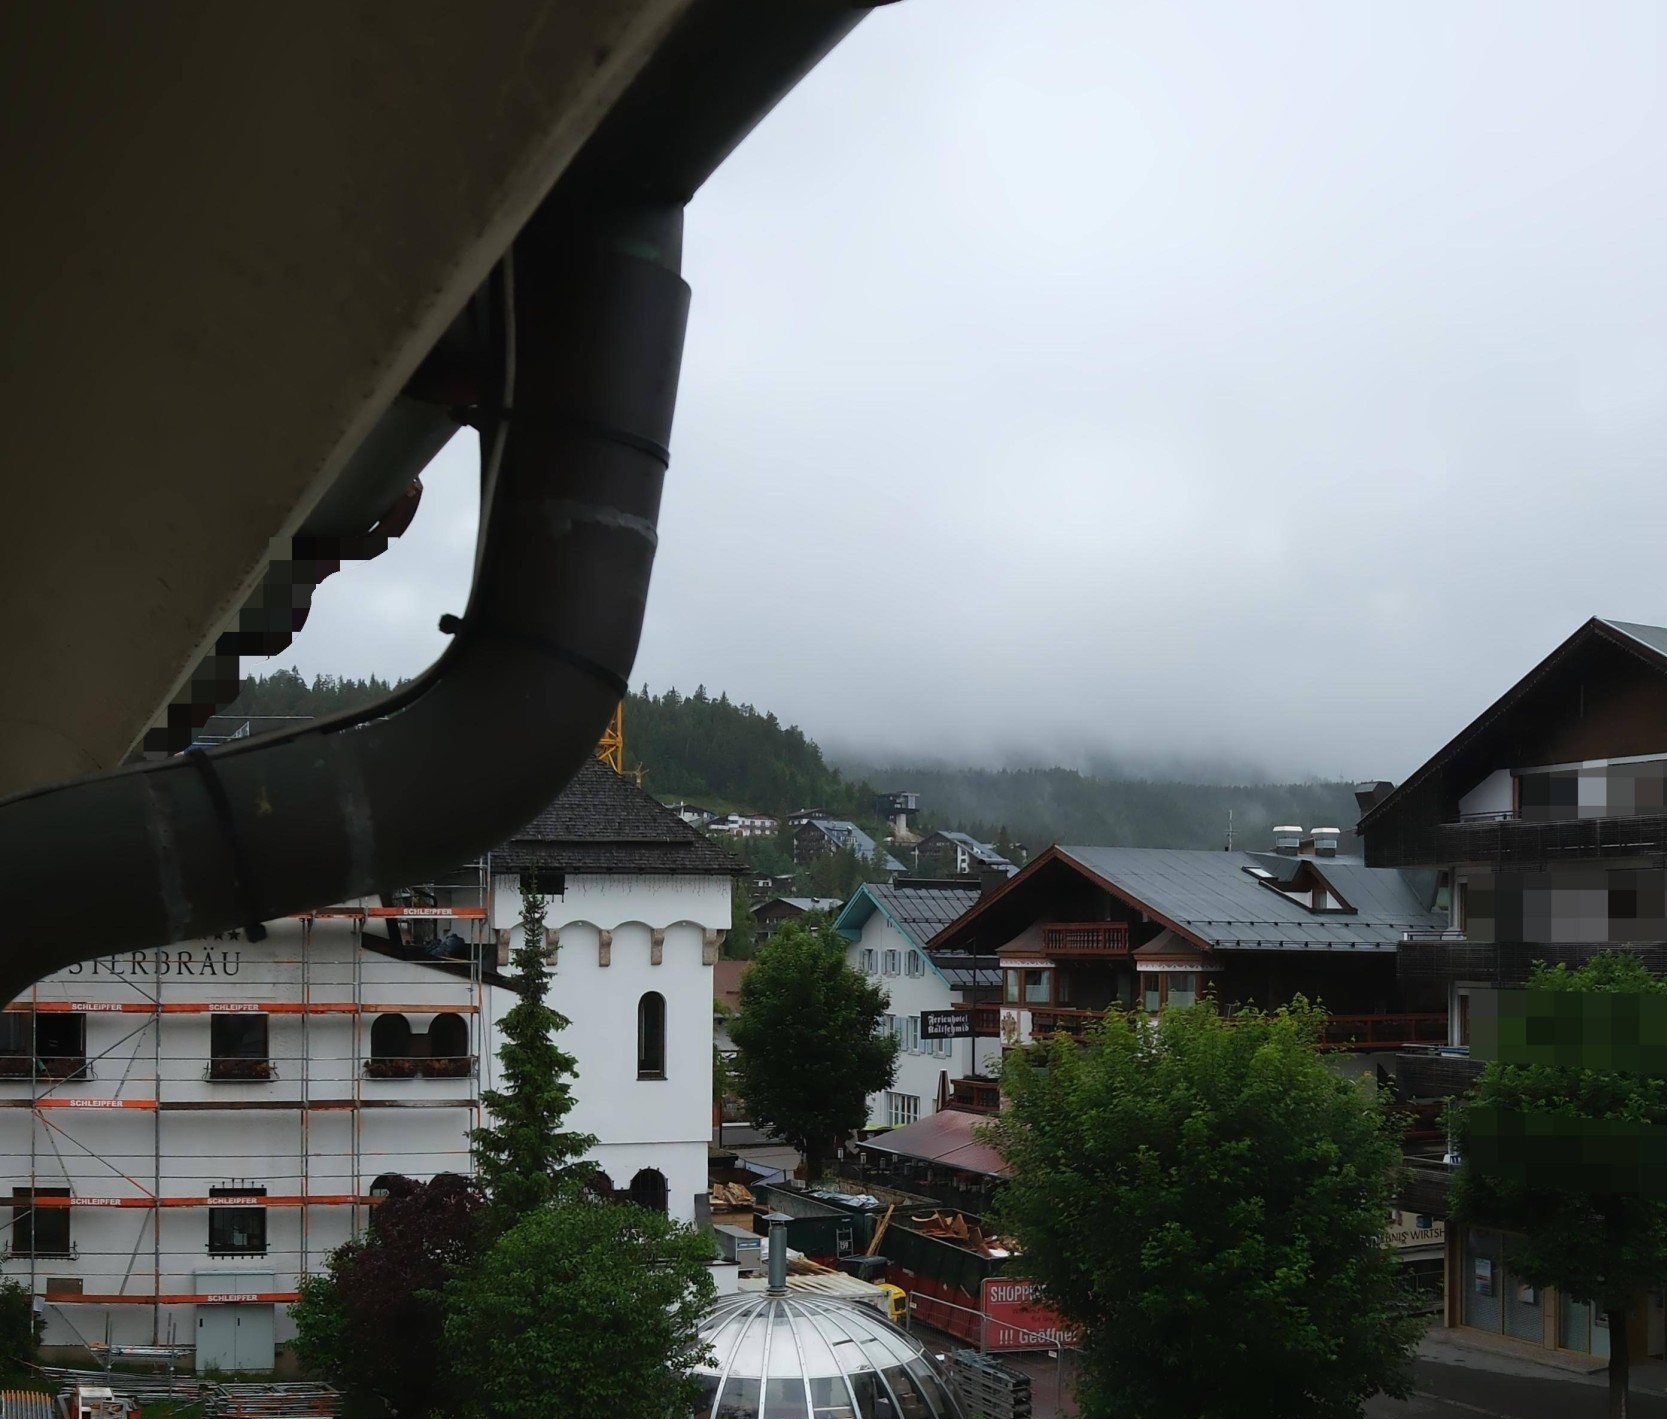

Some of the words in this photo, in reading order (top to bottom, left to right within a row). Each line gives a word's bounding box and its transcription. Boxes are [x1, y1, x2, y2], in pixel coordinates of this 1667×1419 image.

[403, 908, 452, 916] SCHLEIPFER
[56, 947, 241, 976] STERBRÄU
[71, 1003, 122, 1011] SCHLEIPFER
[209, 1003, 259, 1011] SCHLEIPFER
[71, 1198, 121, 1206] SCHLEIPFER
[207, 1197, 257, 1205] SCHLEIPFER
[207, 1294, 257, 1302] SCHLEIPFER
